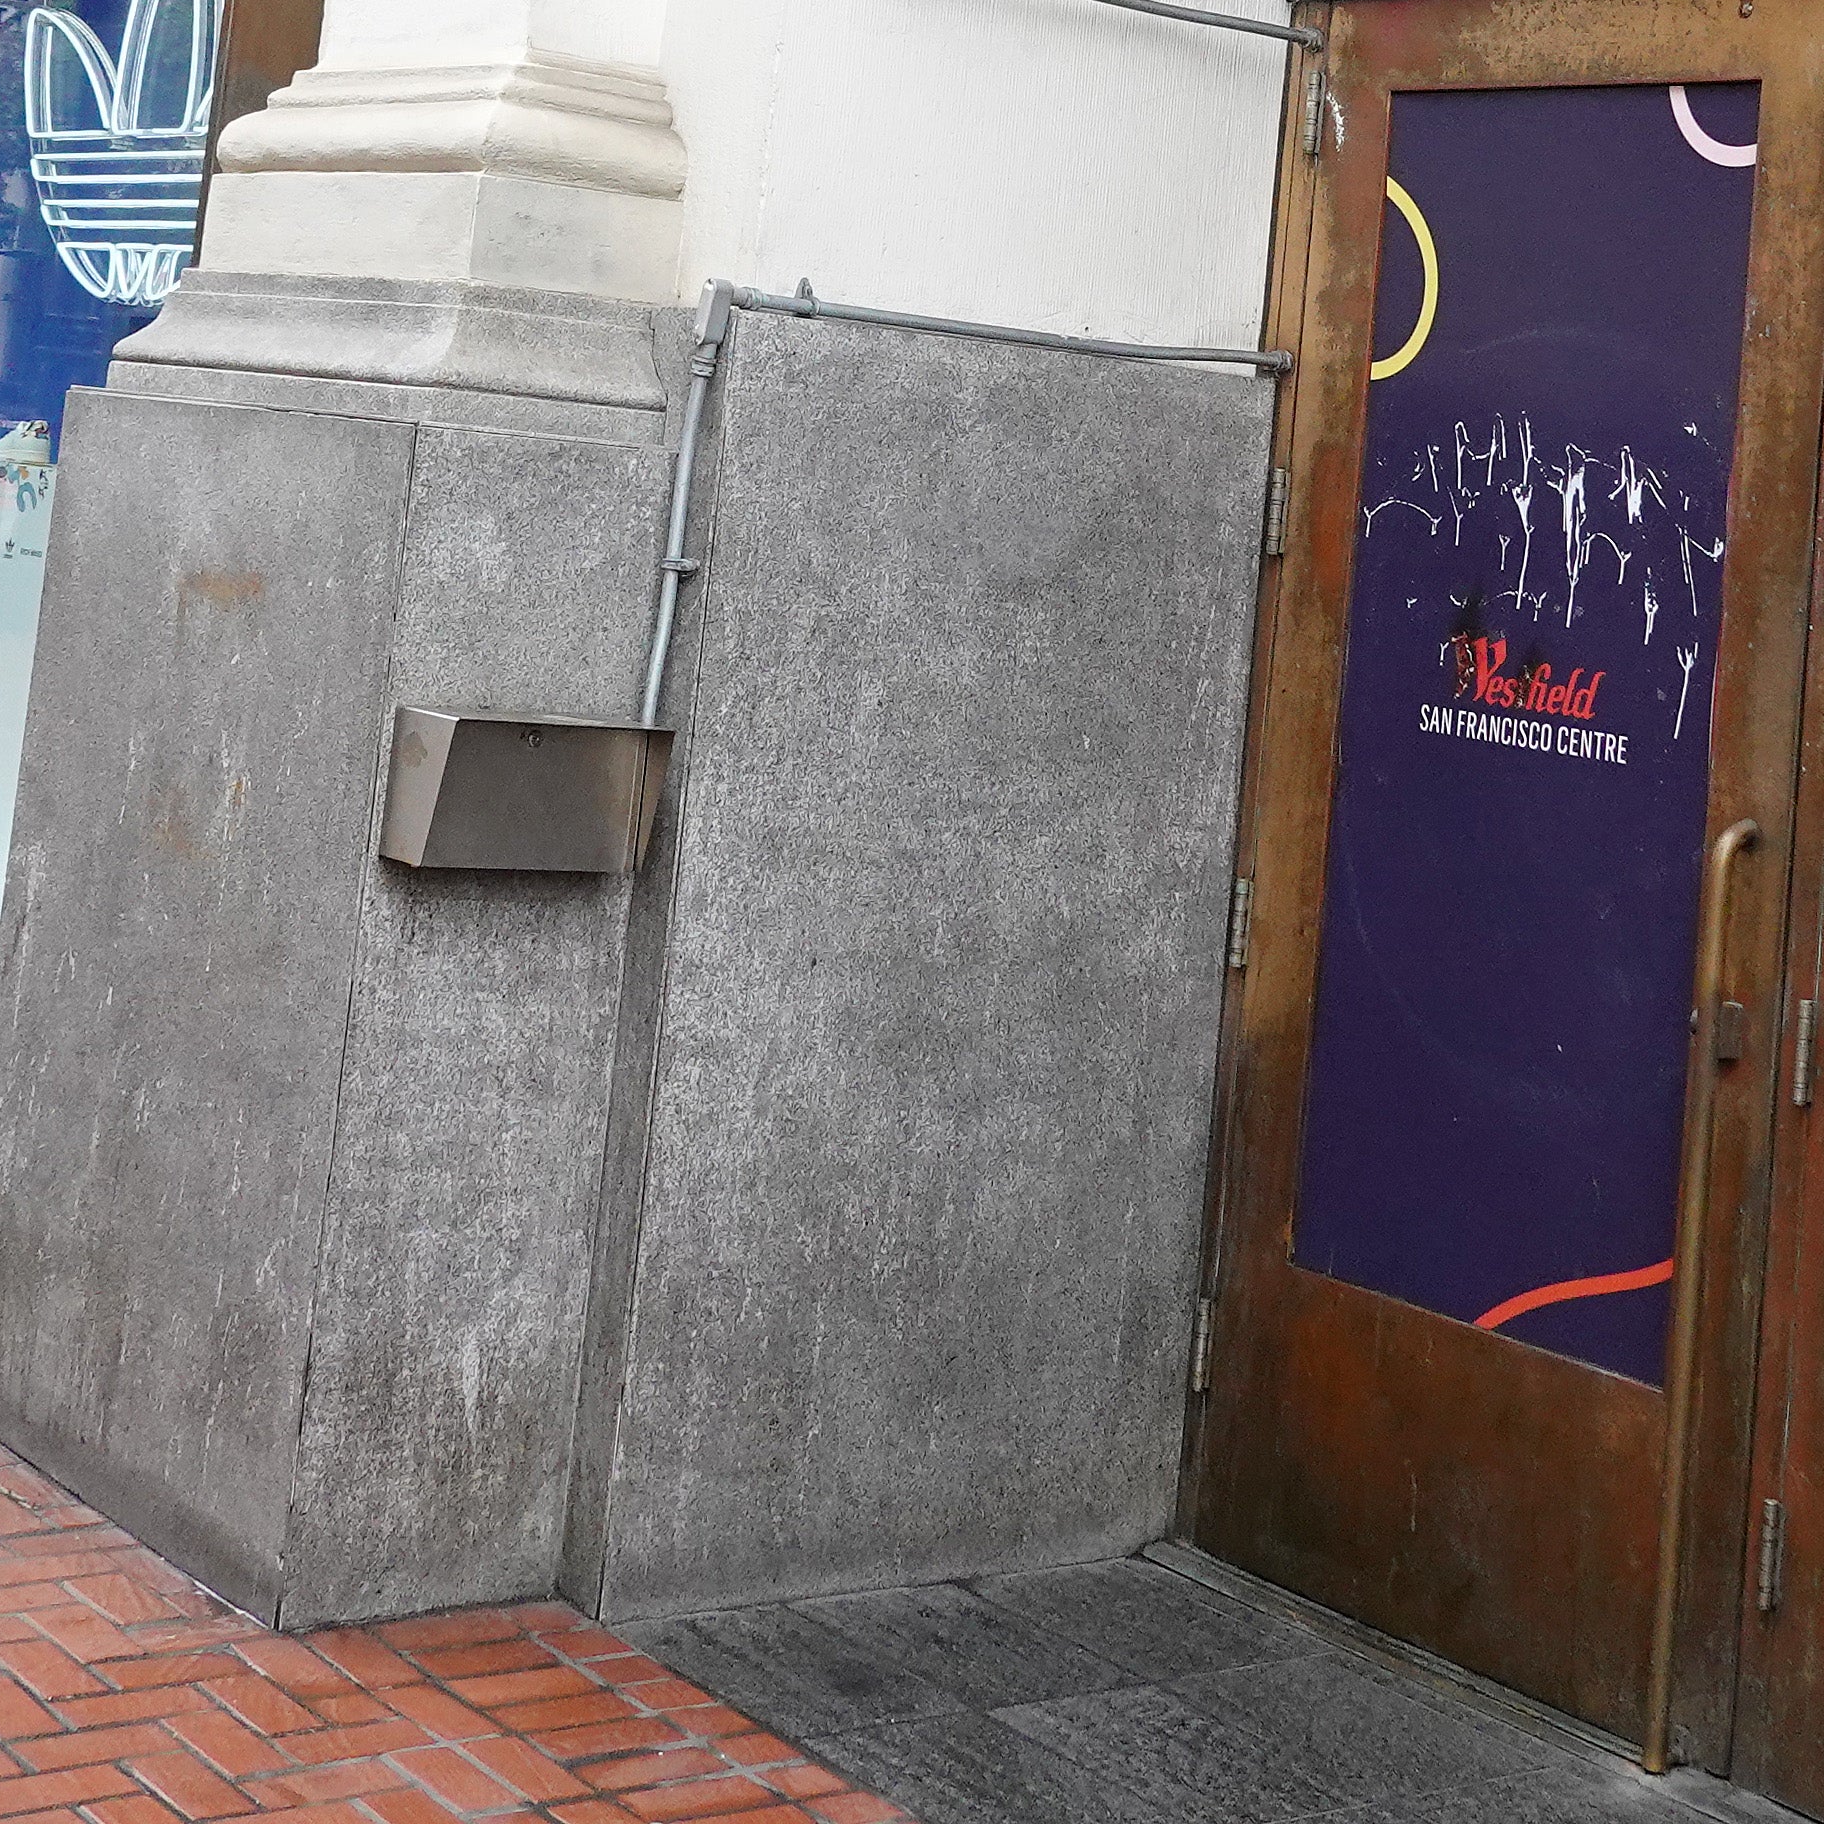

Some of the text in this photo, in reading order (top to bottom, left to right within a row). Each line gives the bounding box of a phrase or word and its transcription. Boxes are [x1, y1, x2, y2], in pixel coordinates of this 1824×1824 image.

[1451, 632, 1607, 720] Wesfield
[1419, 704, 1629, 765] SAN FRANCISCO CENTRE
